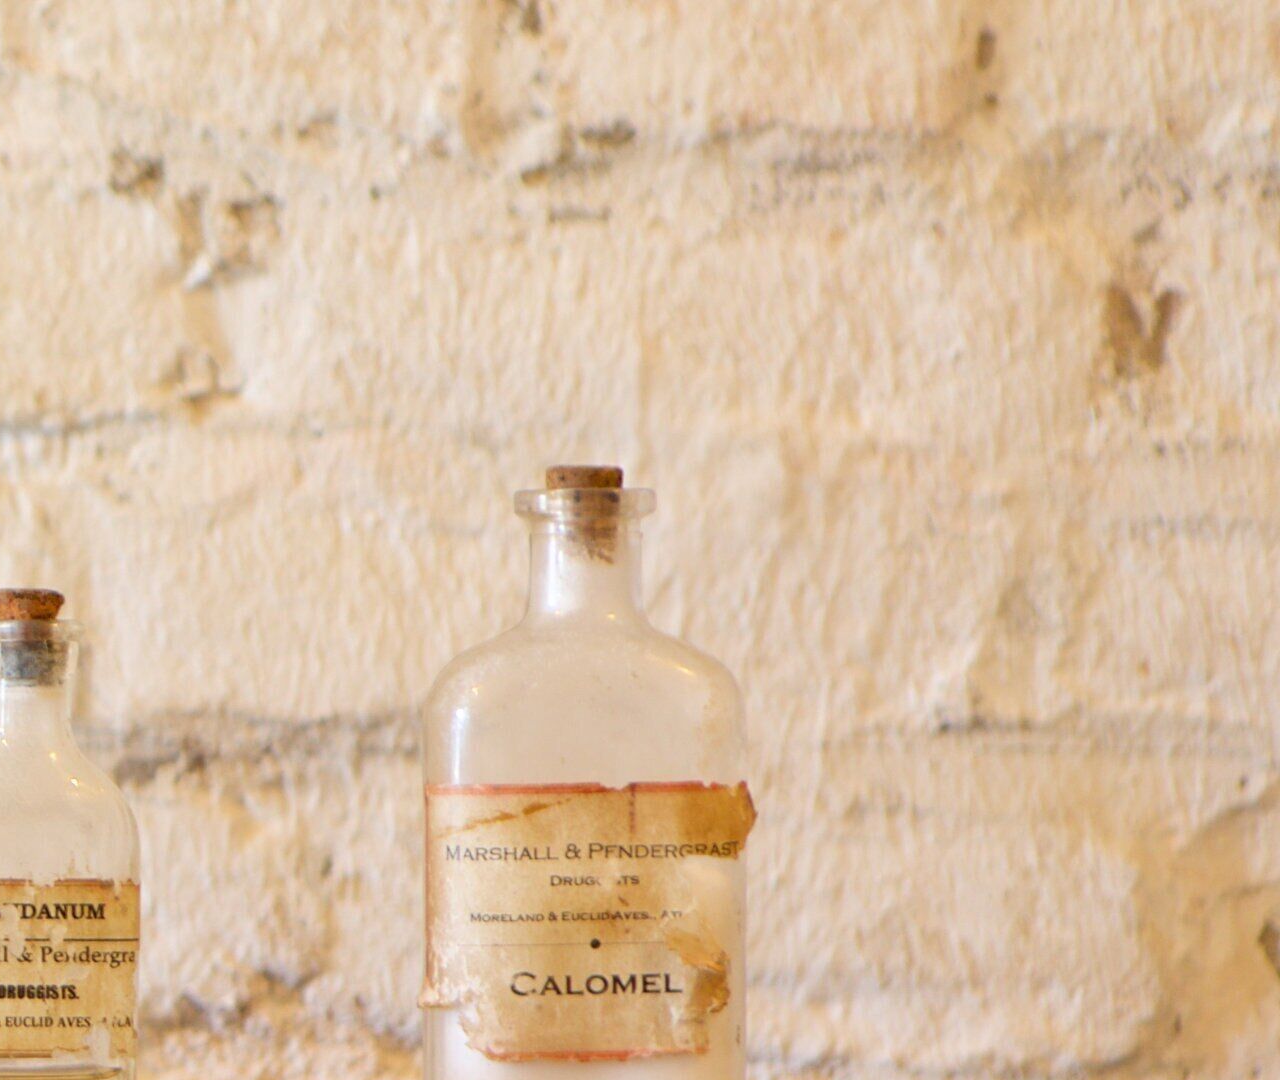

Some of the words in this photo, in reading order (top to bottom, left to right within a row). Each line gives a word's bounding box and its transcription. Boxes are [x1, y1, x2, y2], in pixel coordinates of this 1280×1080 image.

[446, 844, 559, 862] MARSHALL
[565, 843, 581, 860] &
[588, 840, 739, 860] PENDERGRAST
[470, 912, 545, 922] MORELAND
[548, 911, 558, 921] &
[561, 910, 610, 921] EUCLID
[16, 949, 33, 963] &
[510, 971, 683, 996] CALOMEL
[5, 1016, 54, 1028] EUCLID
